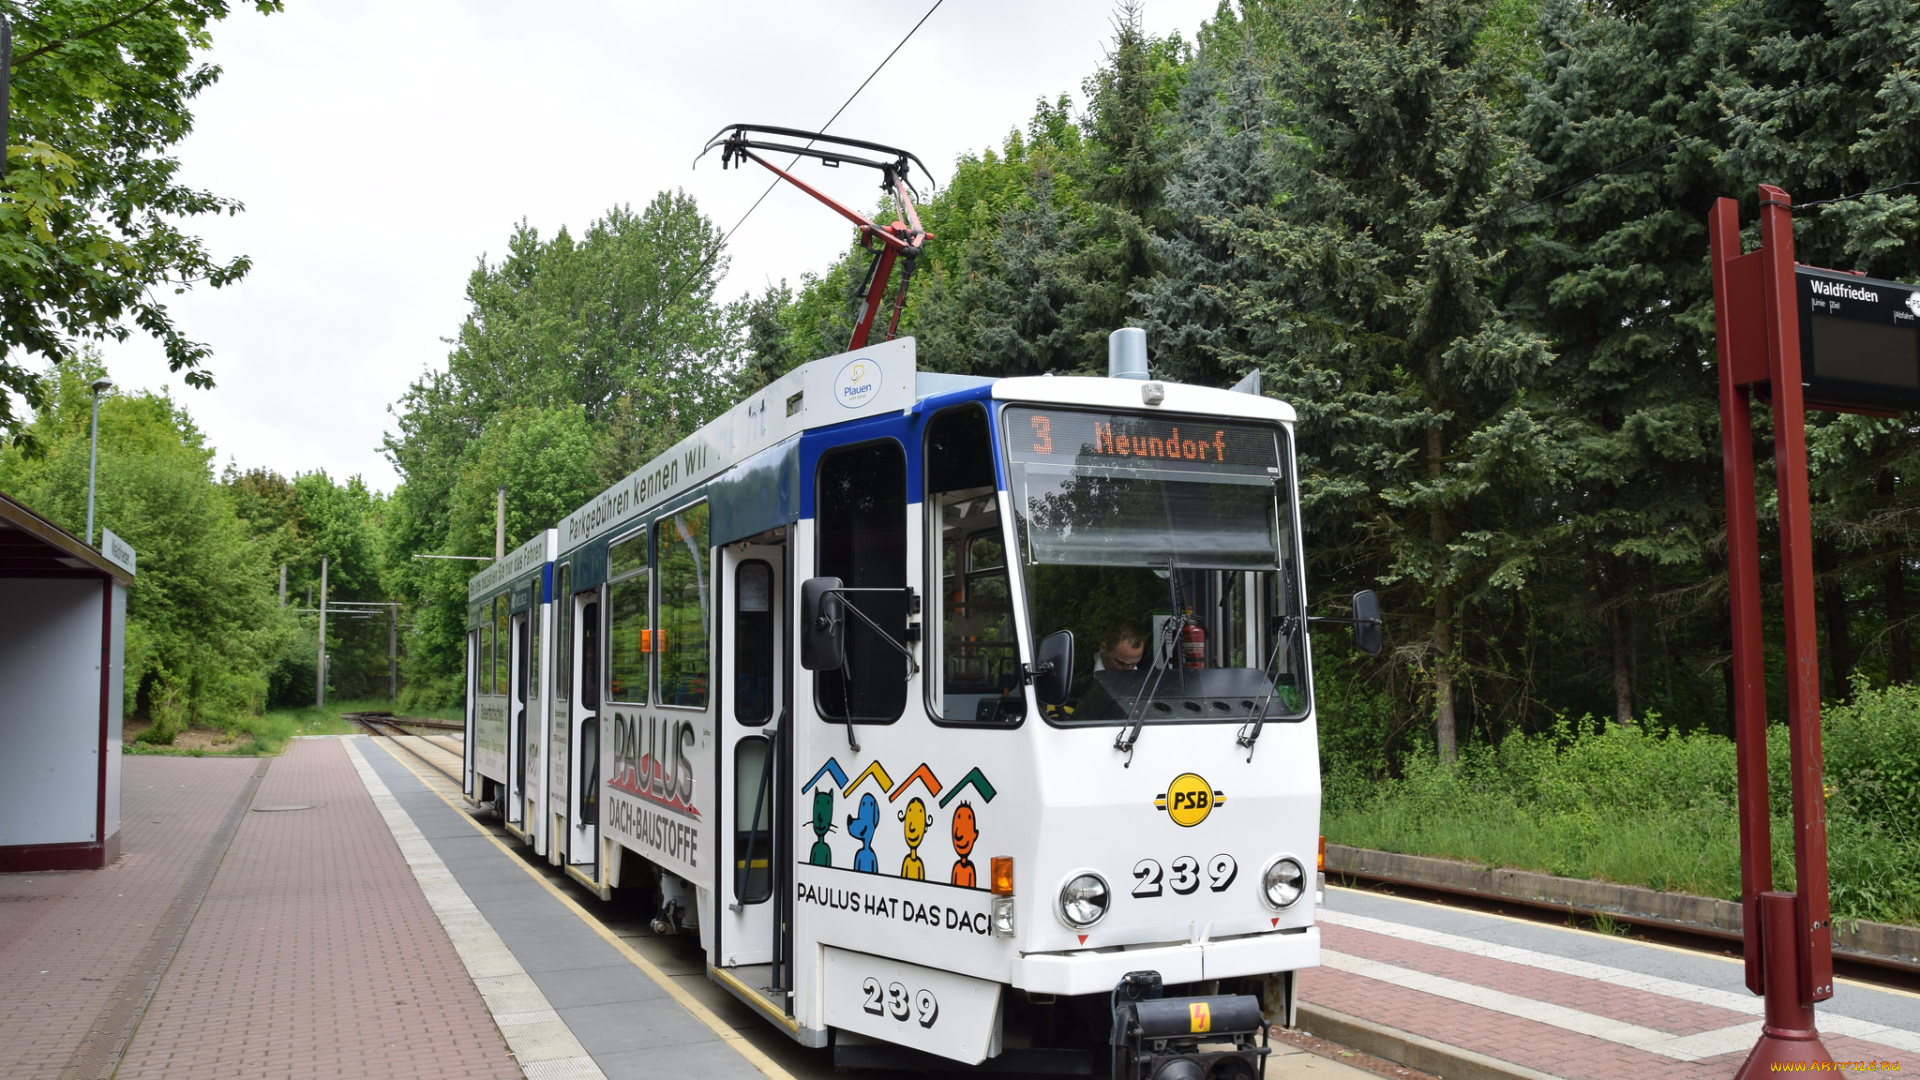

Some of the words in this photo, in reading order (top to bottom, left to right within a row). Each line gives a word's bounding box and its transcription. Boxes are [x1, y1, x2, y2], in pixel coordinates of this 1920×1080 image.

[1810, 279, 1879, 303] Waldfrieden
[1813, 298, 1826, 307] Linie
[1831, 300, 1841, 309] Ziel
[1895, 311, 1914, 321] Abfahrt
[844, 383, 872, 397] Plauen
[1030, 415, 1053, 455] 3
[1094, 421, 1226, 461] Neundorf
[568, 489, 630, 543] Parkgebühren
[633, 457, 679, 507] kennen
[684, 444, 708, 477] wir
[514, 553, 523, 573] das
[523, 542, 542, 568] Fahren
[613, 712, 696, 807] PAULUS
[1173, 790, 1208, 810] PSB
[608, 796, 698, 868] DACH-BAUSTOFFE
[1131, 853, 1239, 899] 239
[797, 882, 861, 912] PAULUS
[864, 894, 899, 919] HAT
[902, 900, 941, 926] DAS
[863, 976, 939, 1029] 239
